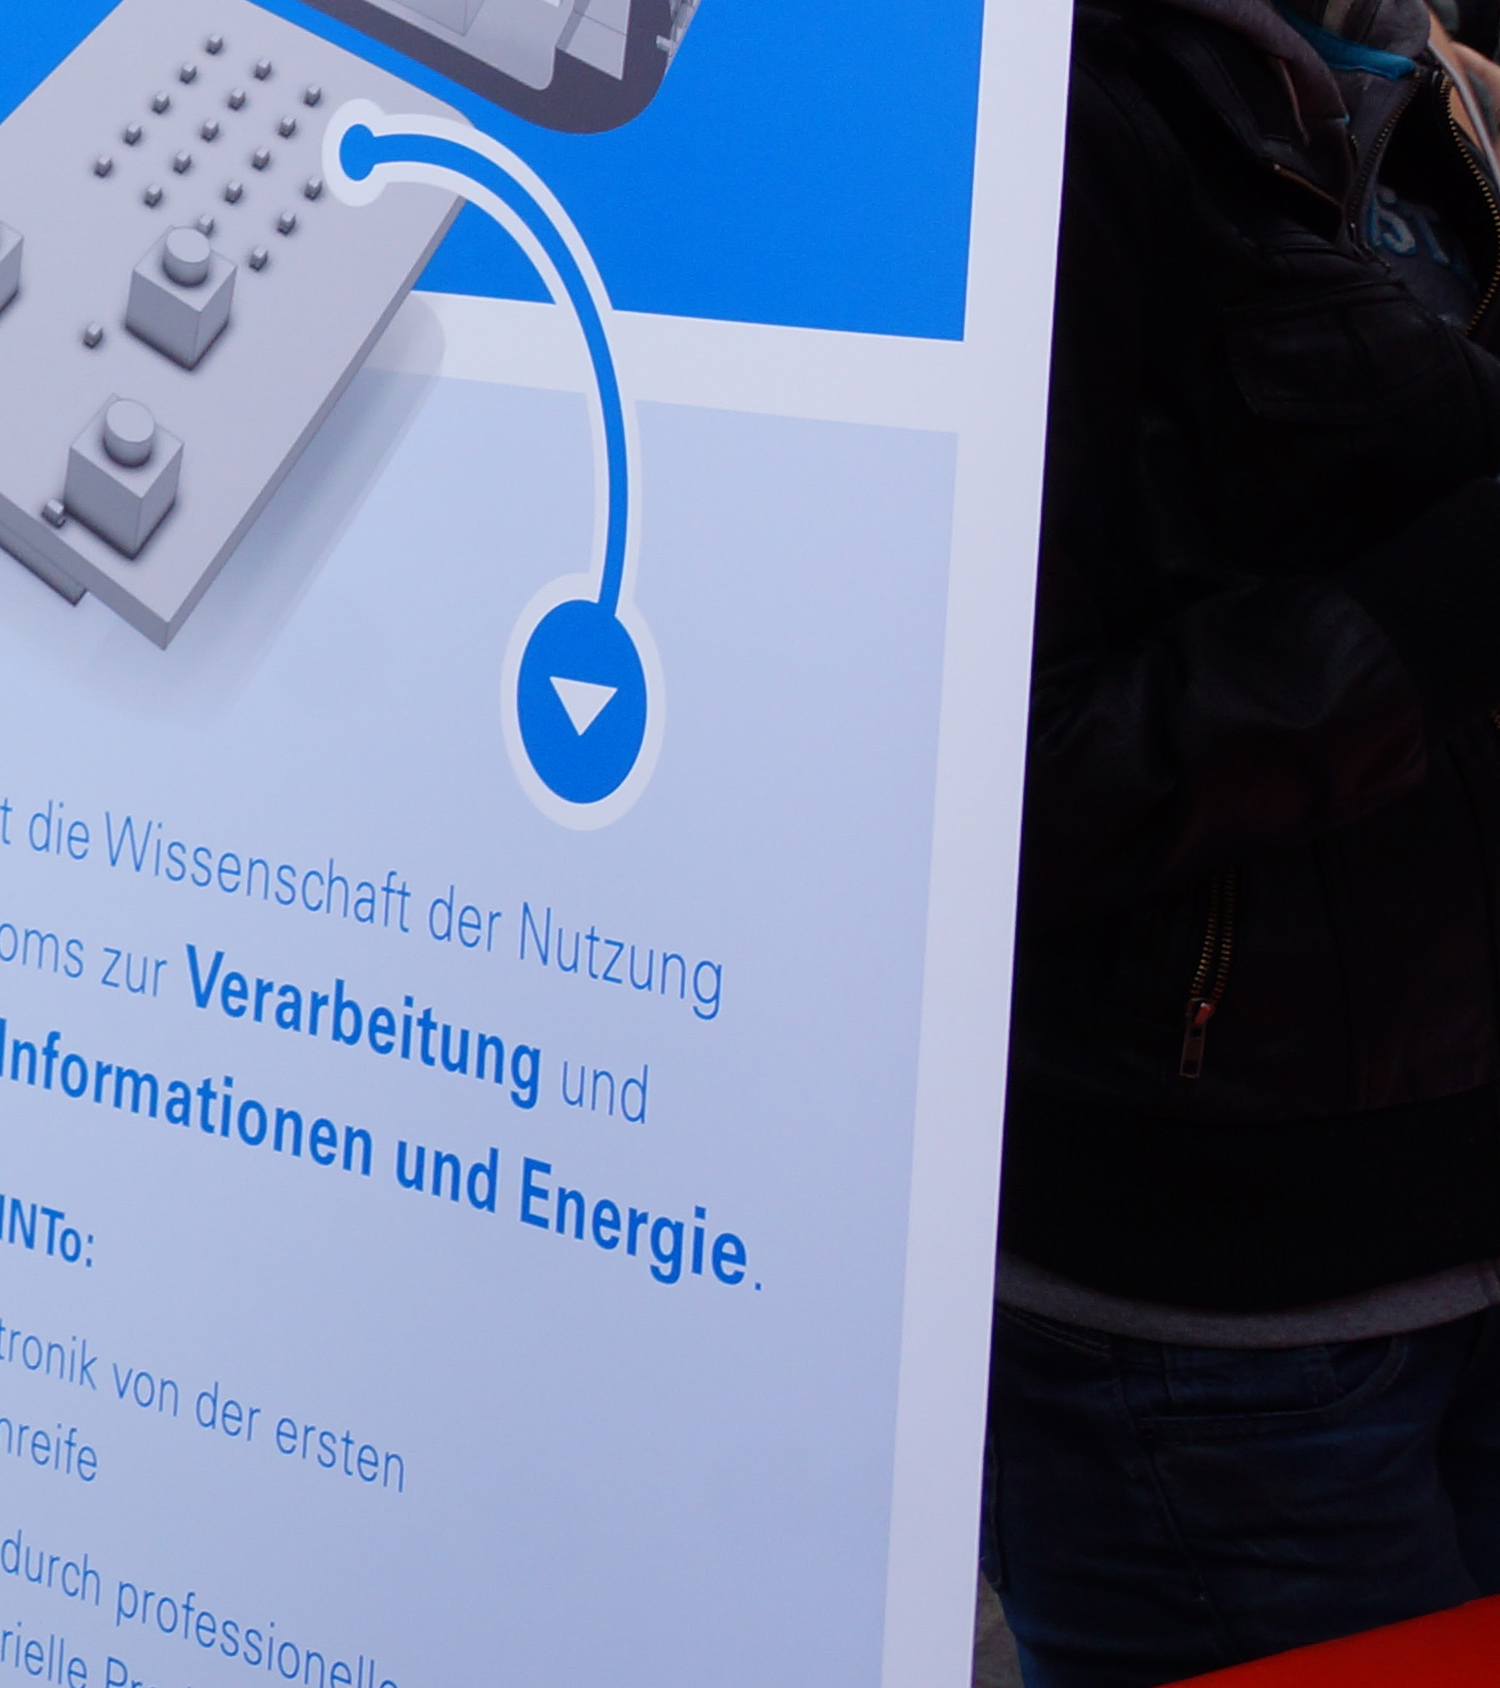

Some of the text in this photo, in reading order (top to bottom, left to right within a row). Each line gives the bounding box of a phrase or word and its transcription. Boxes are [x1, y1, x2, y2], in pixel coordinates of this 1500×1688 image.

[29, 801, 89, 860] die
[106, 812, 411, 933] Wissenschaft
[429, 885, 502, 951] der
[521, 902, 722, 1020] Nutzung
[101, 948, 167, 997] zur
[187, 944, 540, 1109] Verarbeitung
[563, 1062, 648, 1124] und
[397, 1141, 498, 1213] und
[521, 1158, 761, 1290] Energie.
[113, 1363, 178, 1417] von
[196, 1382, 261, 1441] der
[276, 1418, 404, 1492] ersten
[1, 1530, 100, 1606] durch
